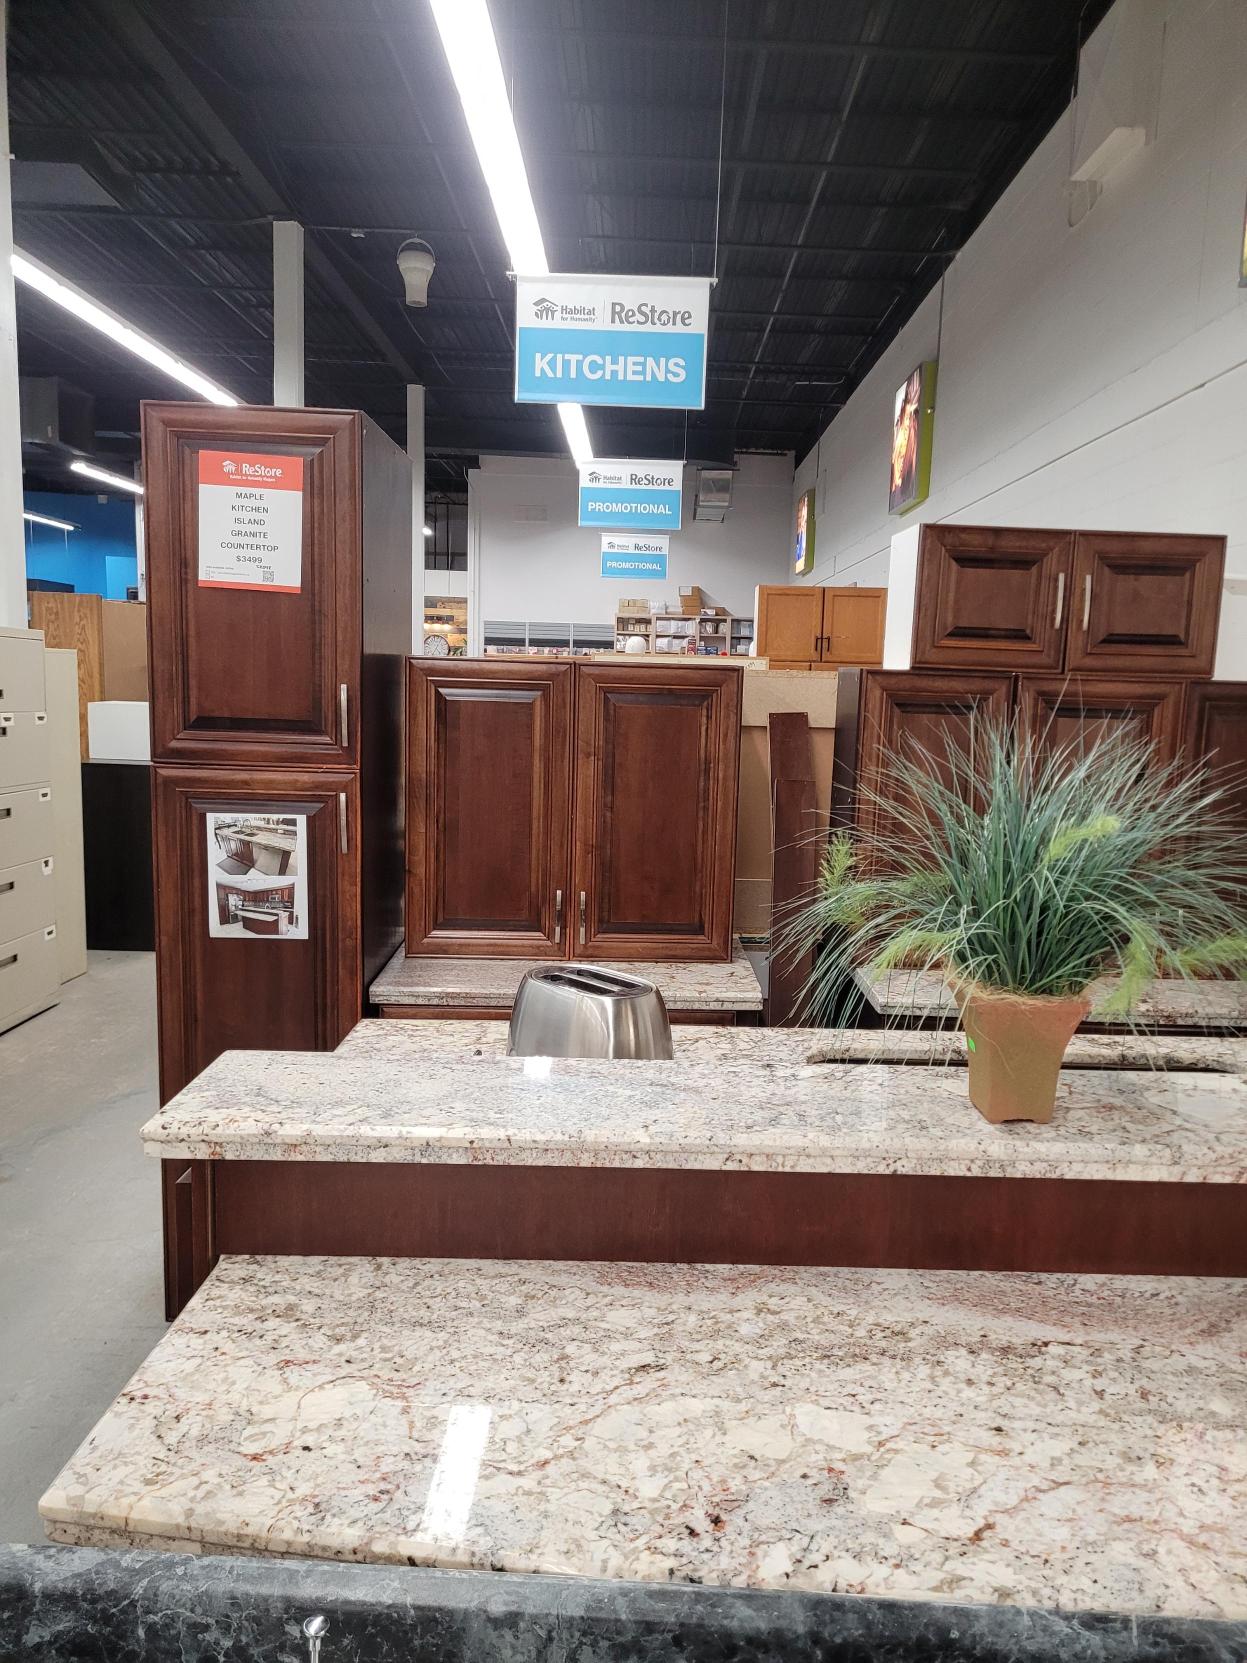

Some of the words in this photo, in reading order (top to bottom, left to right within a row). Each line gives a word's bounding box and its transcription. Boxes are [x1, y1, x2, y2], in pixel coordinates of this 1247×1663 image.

[561, 305, 596, 316] Habitat
[611, 302, 692, 326] ReStore
[535, 352, 686, 383] KITCHENS
[242, 463, 282, 476] ReStore
[630, 473, 674, 486] ReStore
[235, 492, 265, 501] MAPLE
[231, 504, 269, 514] KITCHEN
[588, 502, 672, 514] PROMOTIONAL
[234, 517, 266, 526] ISLAND
[230, 529, 269, 539] GRANITE
[220, 541, 279, 552] COUNTERTOP
[634, 543, 663, 552] ReStore
[236, 555, 263, 564] $3499
[607, 560, 662, 570] PROMOTIONAL
